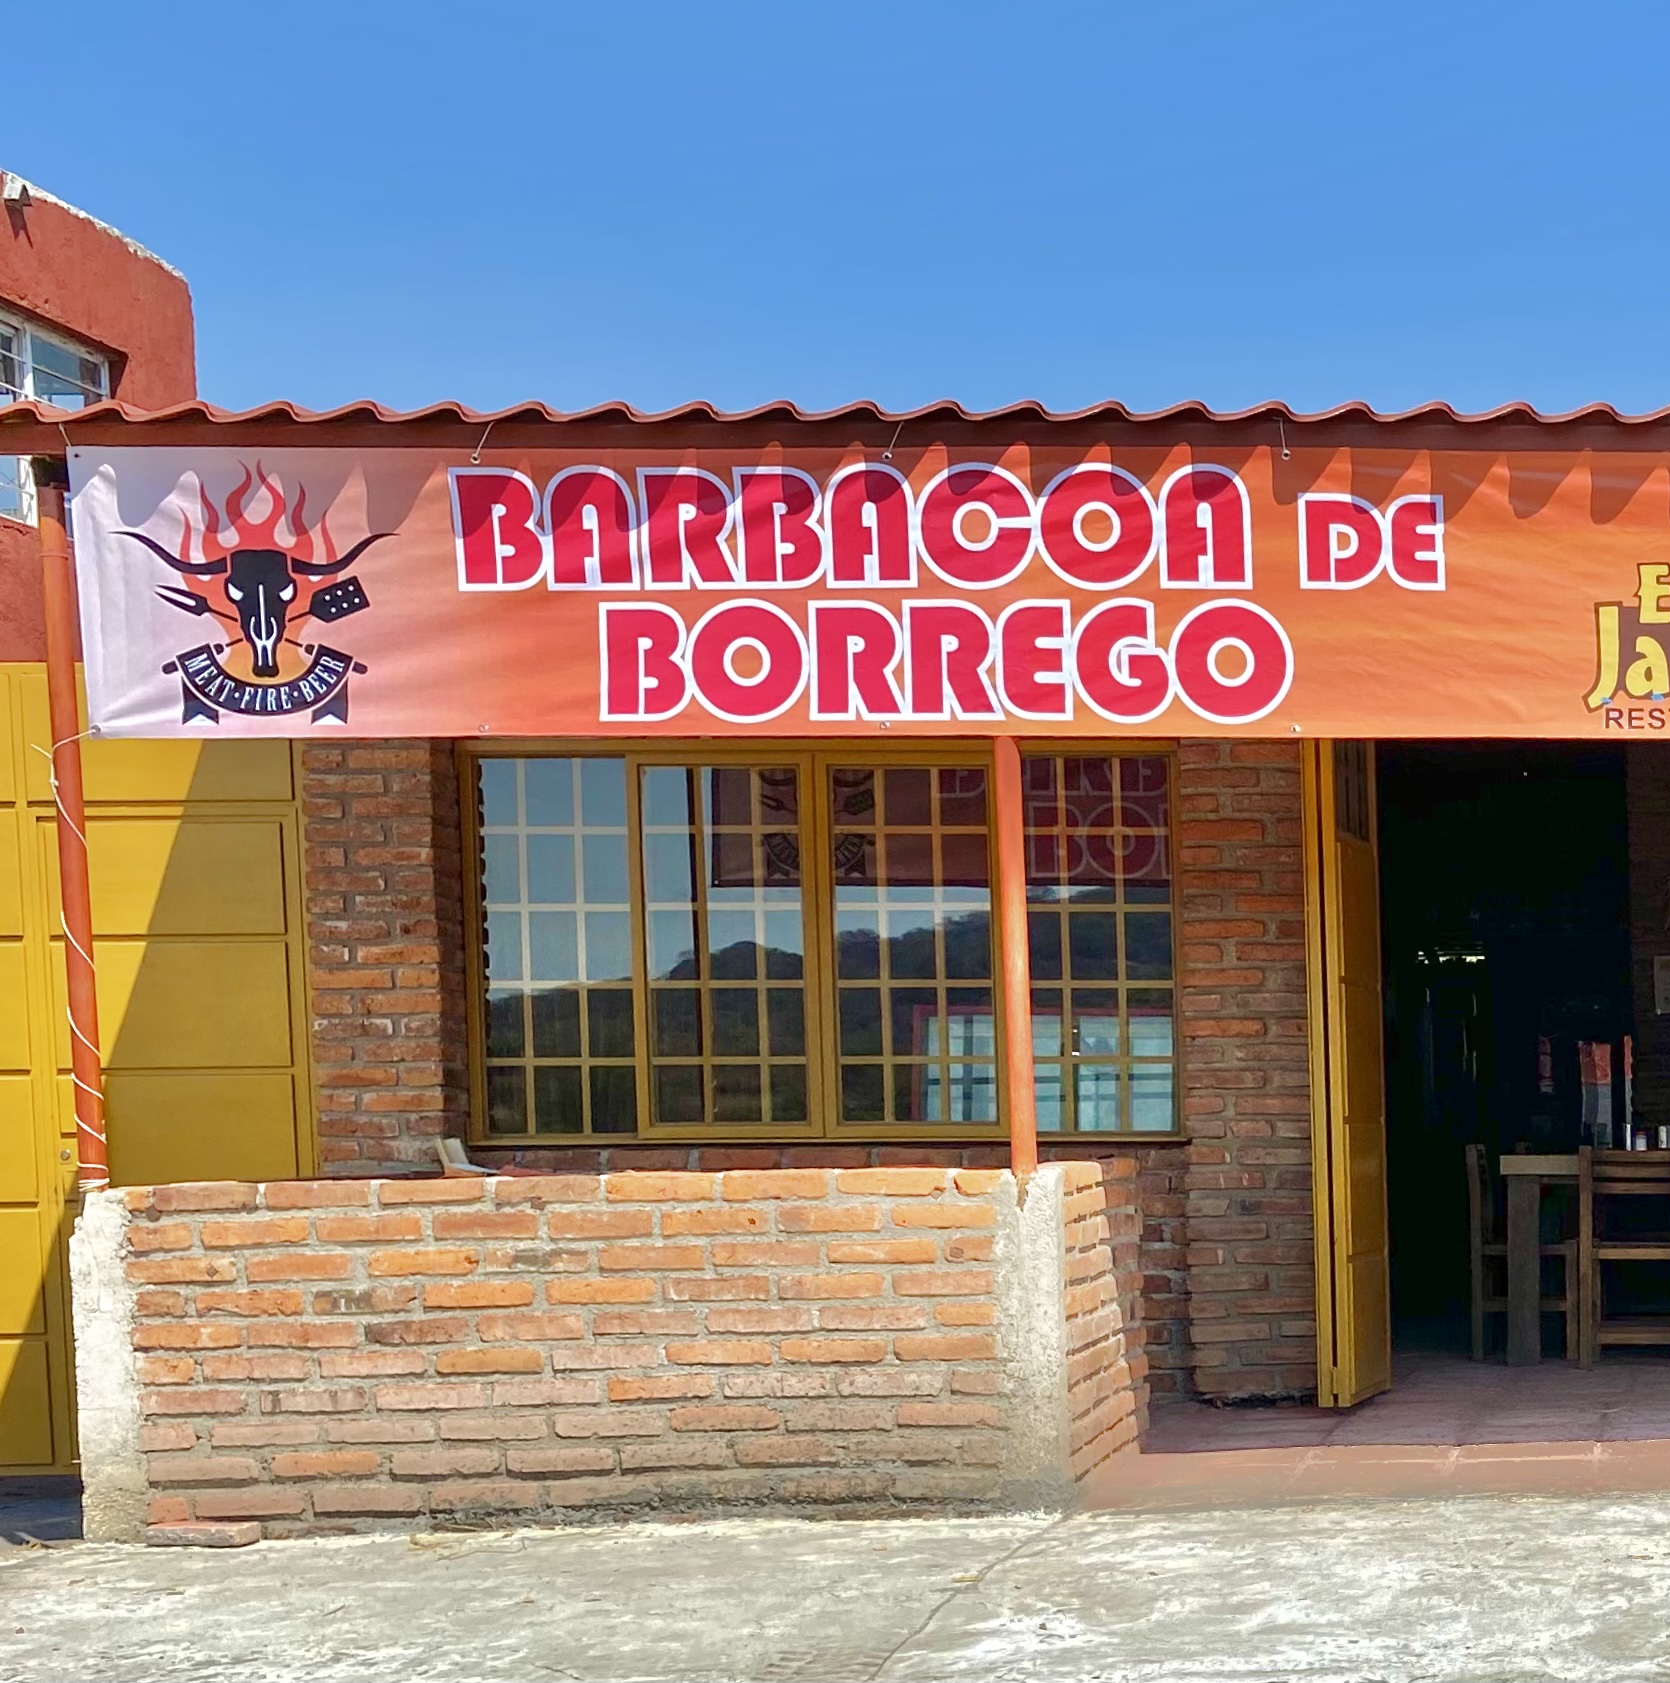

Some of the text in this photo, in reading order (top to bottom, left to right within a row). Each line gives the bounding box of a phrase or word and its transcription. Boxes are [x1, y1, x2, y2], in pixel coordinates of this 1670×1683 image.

[448, 462, 1446, 592] BARBACOA DE
[185, 652, 346, 711] MEAT FIRE BEER
[600, 597, 1294, 725] BORREGO
